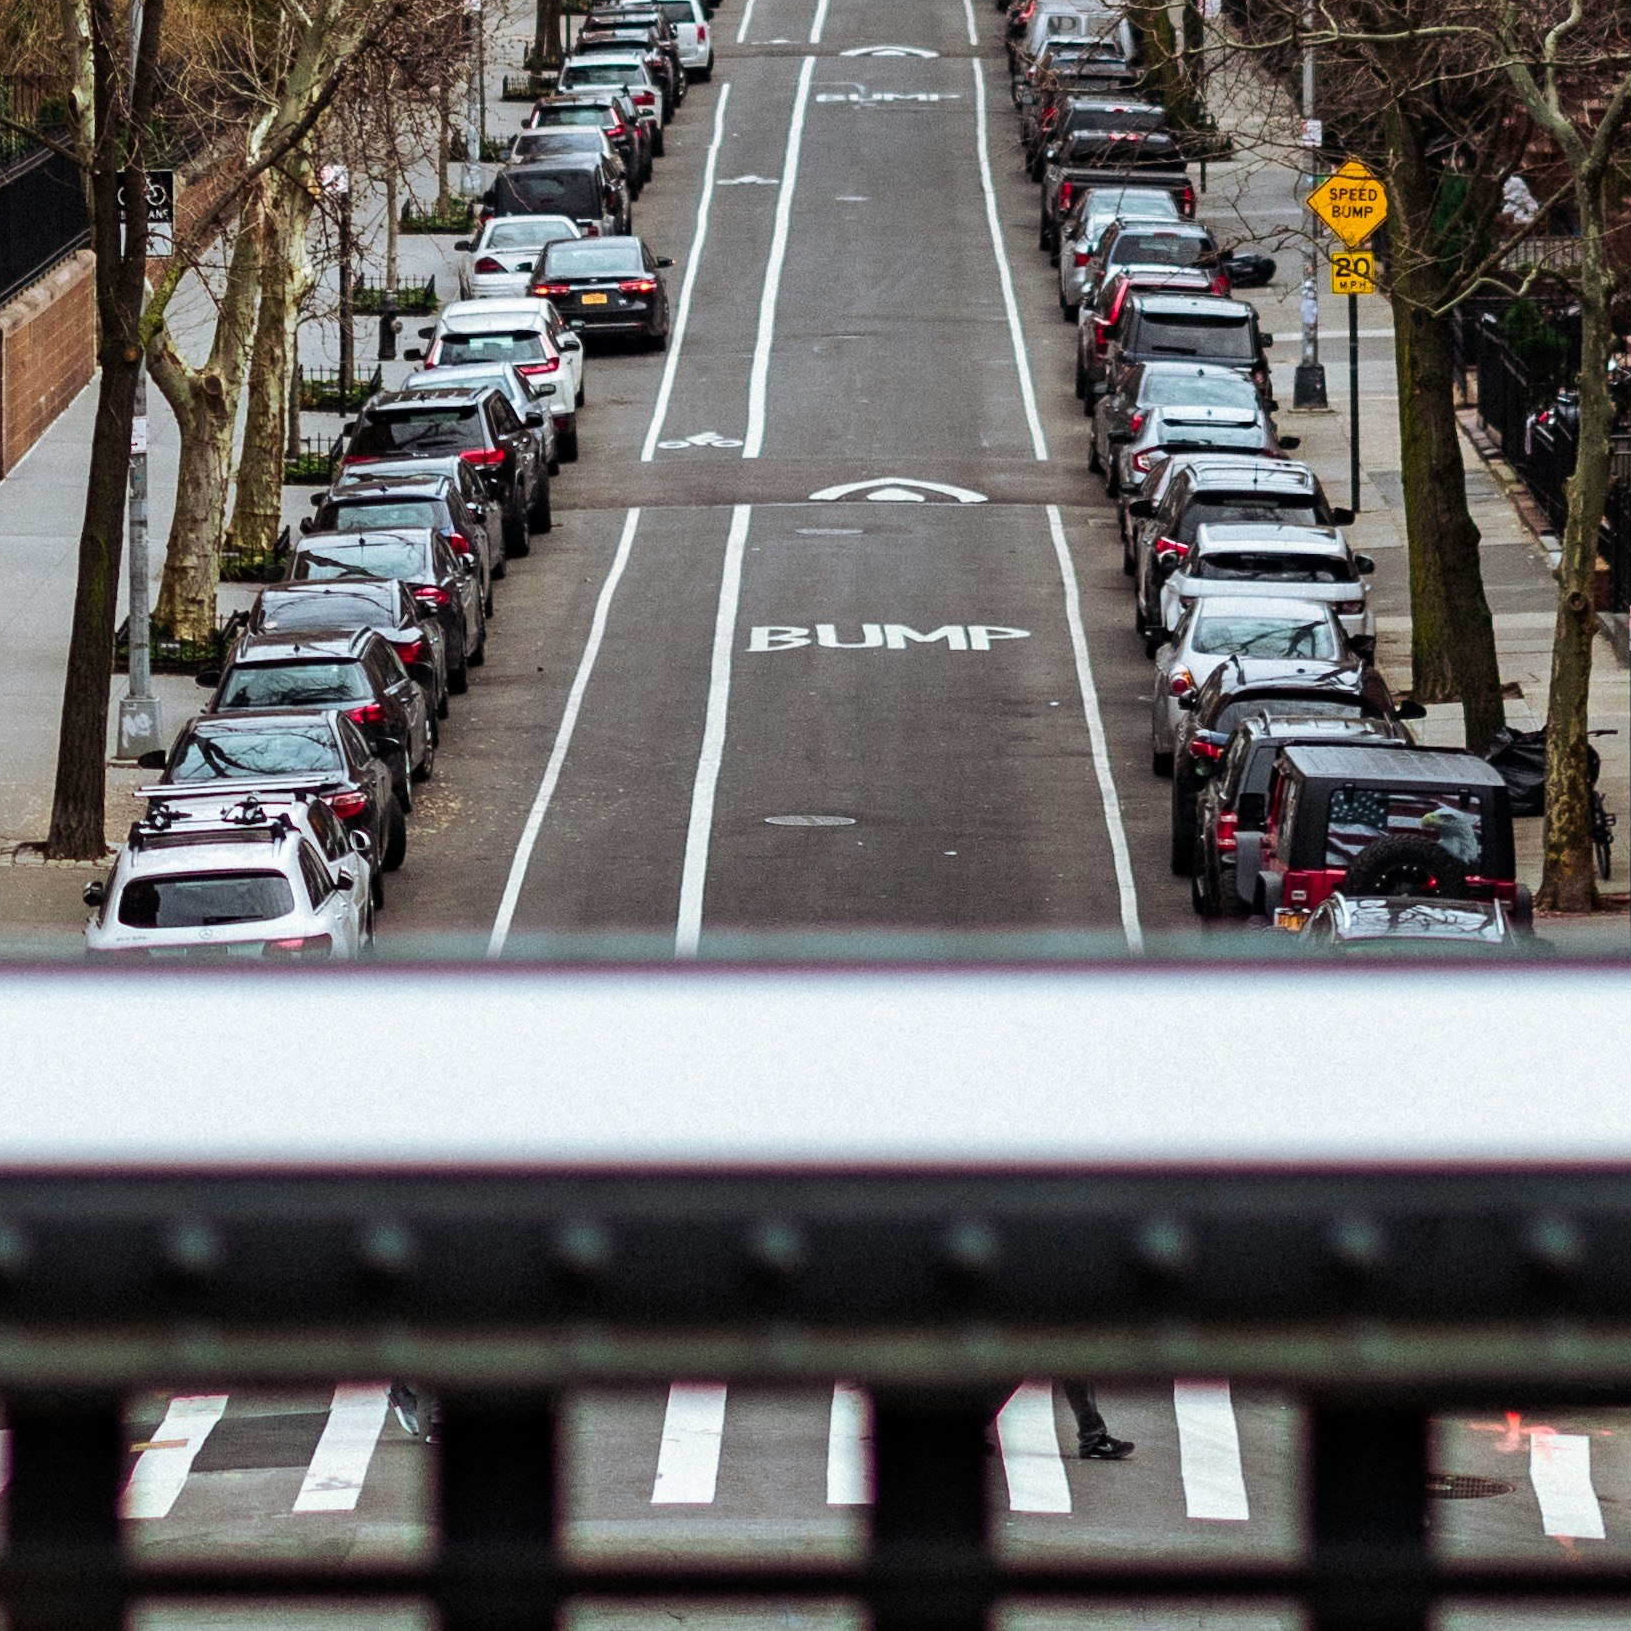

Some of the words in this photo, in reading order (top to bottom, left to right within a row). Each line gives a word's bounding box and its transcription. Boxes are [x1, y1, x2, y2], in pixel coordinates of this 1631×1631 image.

[1330, 188, 1377, 201] SPEED
[1332, 206, 1373, 218] BUMP
[1335, 257, 1371, 278] 20
[1339, 281, 1368, 290] MPH
[746, 623, 1031, 652] BUMP
